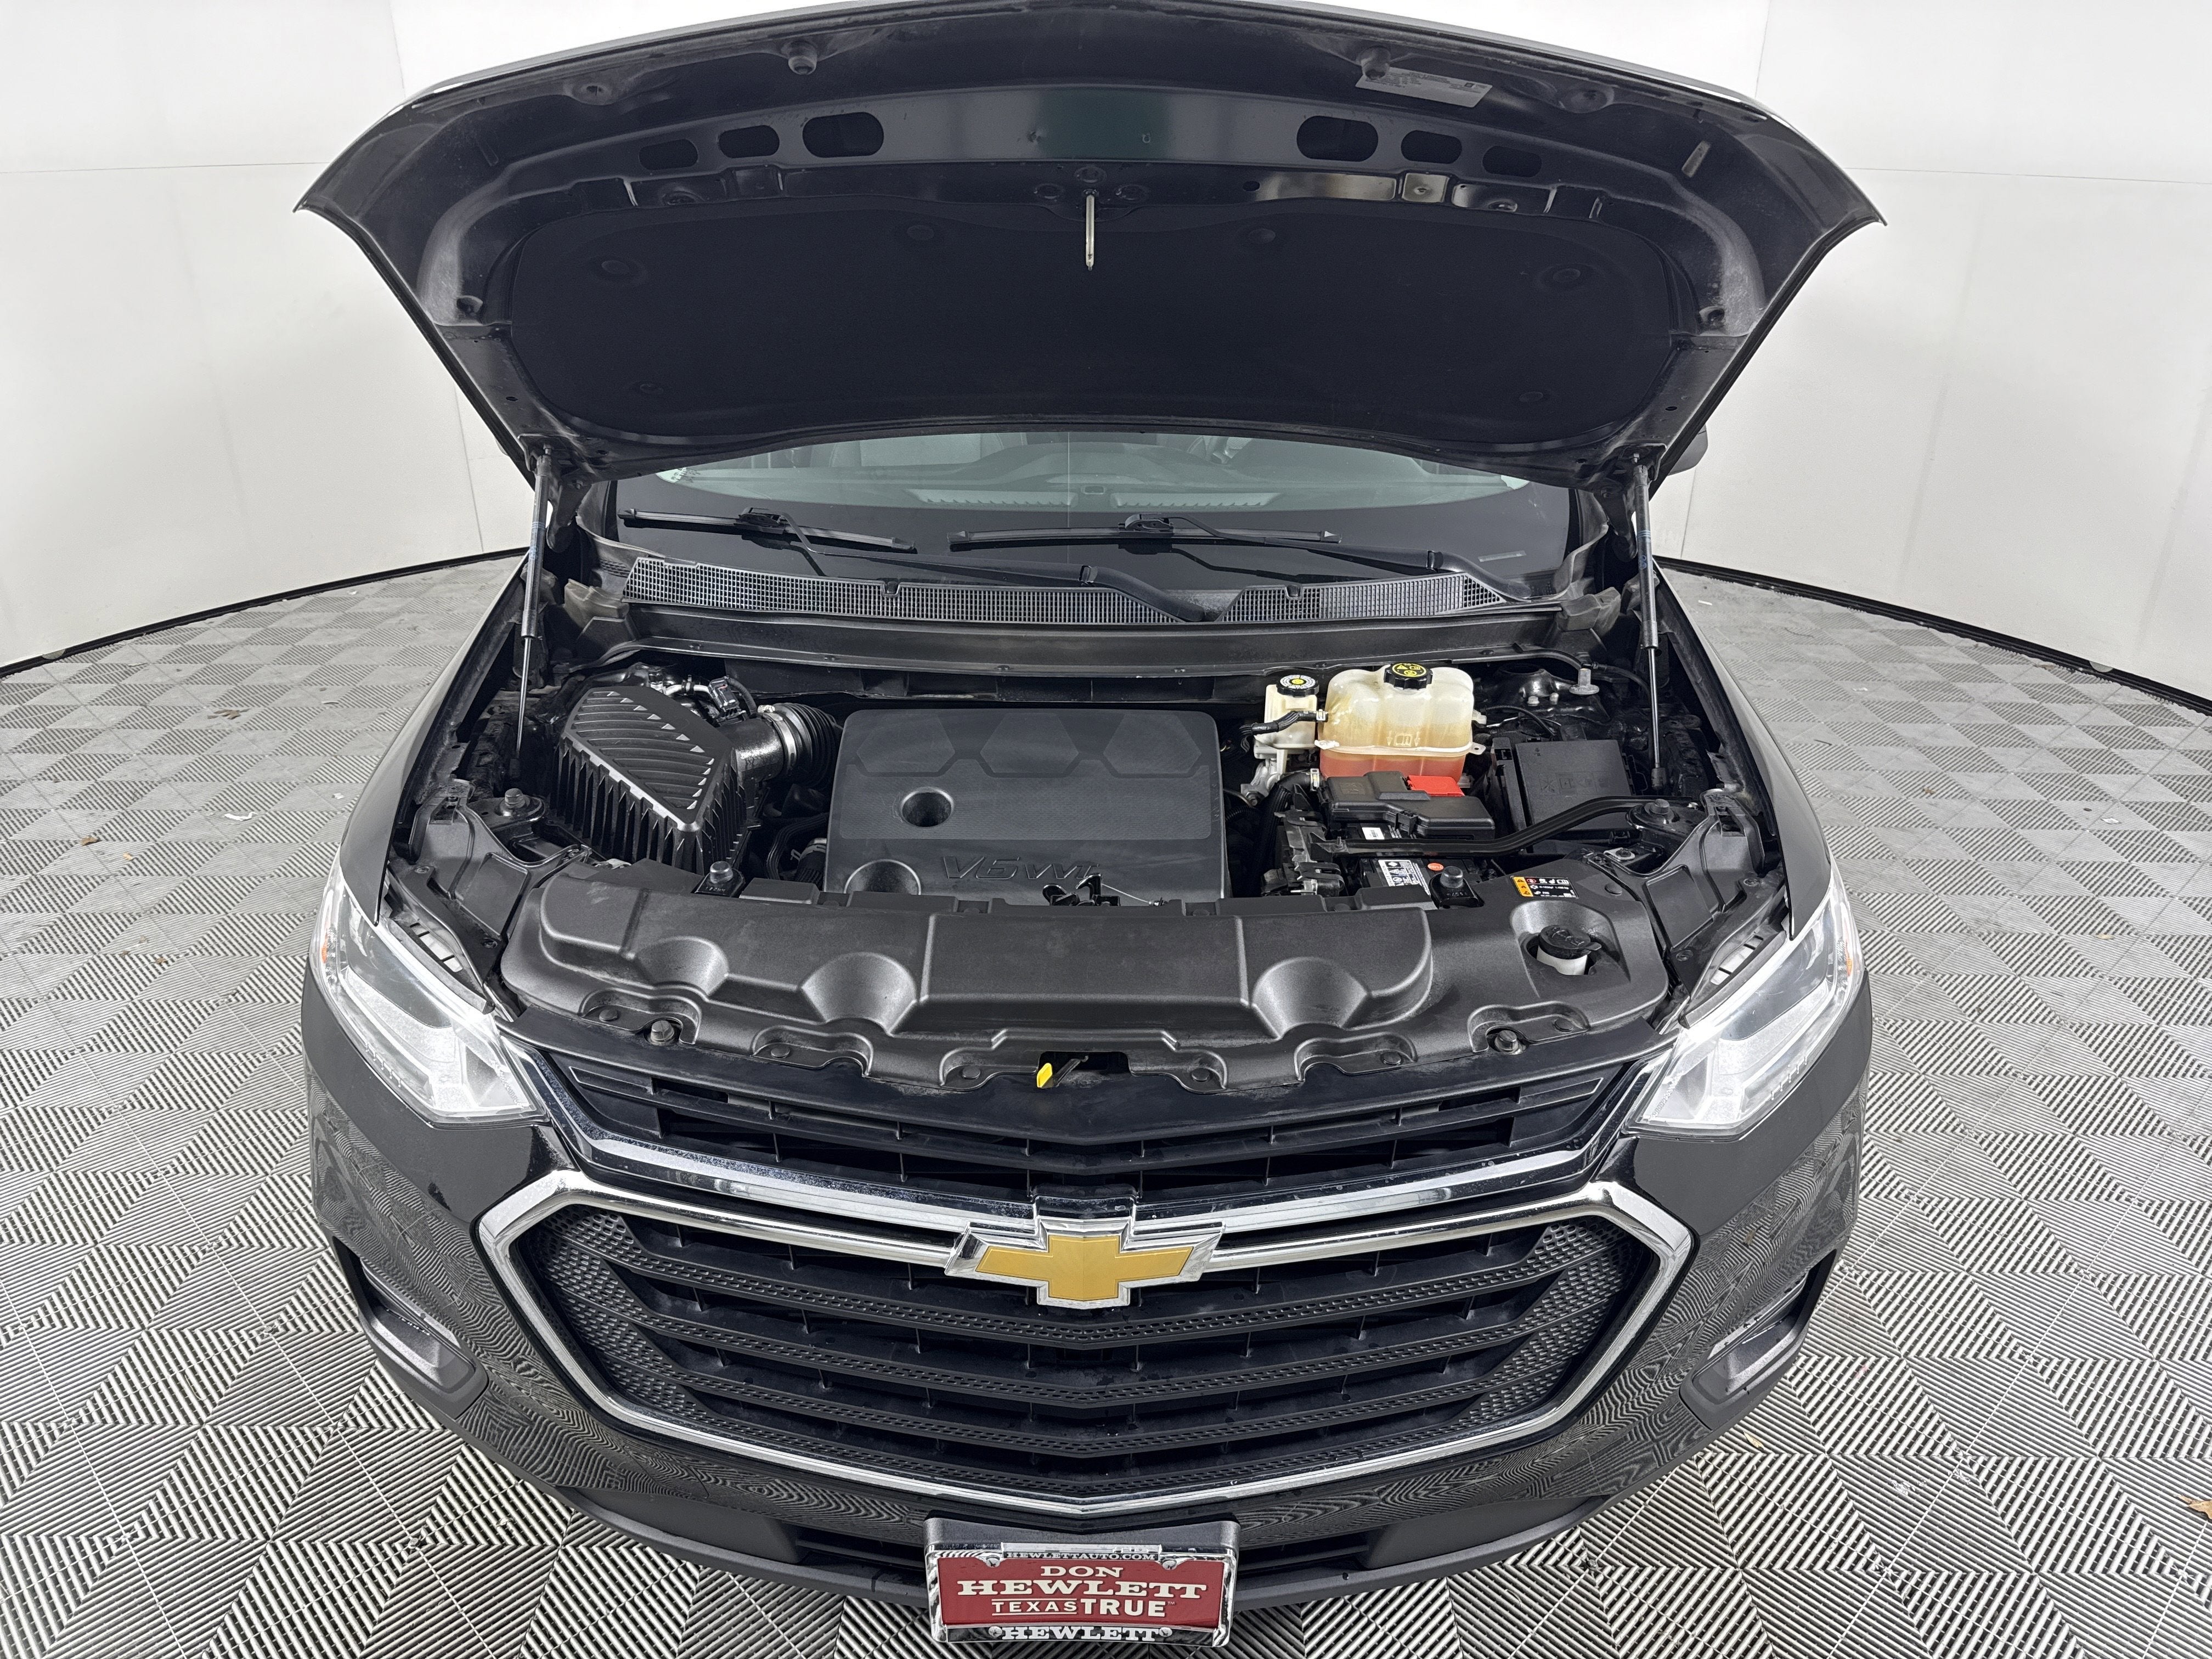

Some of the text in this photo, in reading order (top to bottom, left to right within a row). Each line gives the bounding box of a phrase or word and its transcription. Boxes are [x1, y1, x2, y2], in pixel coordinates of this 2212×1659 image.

[943, 856, 1020, 879] V6
[1007, 1552, 1155, 1560] HEWLETTAUTO.COM
[1041, 1566, 1123, 1577] DON
[957, 1579, 1207, 1599] HEWLETT
[1002, 1626, 1159, 1641] HEWLETT
